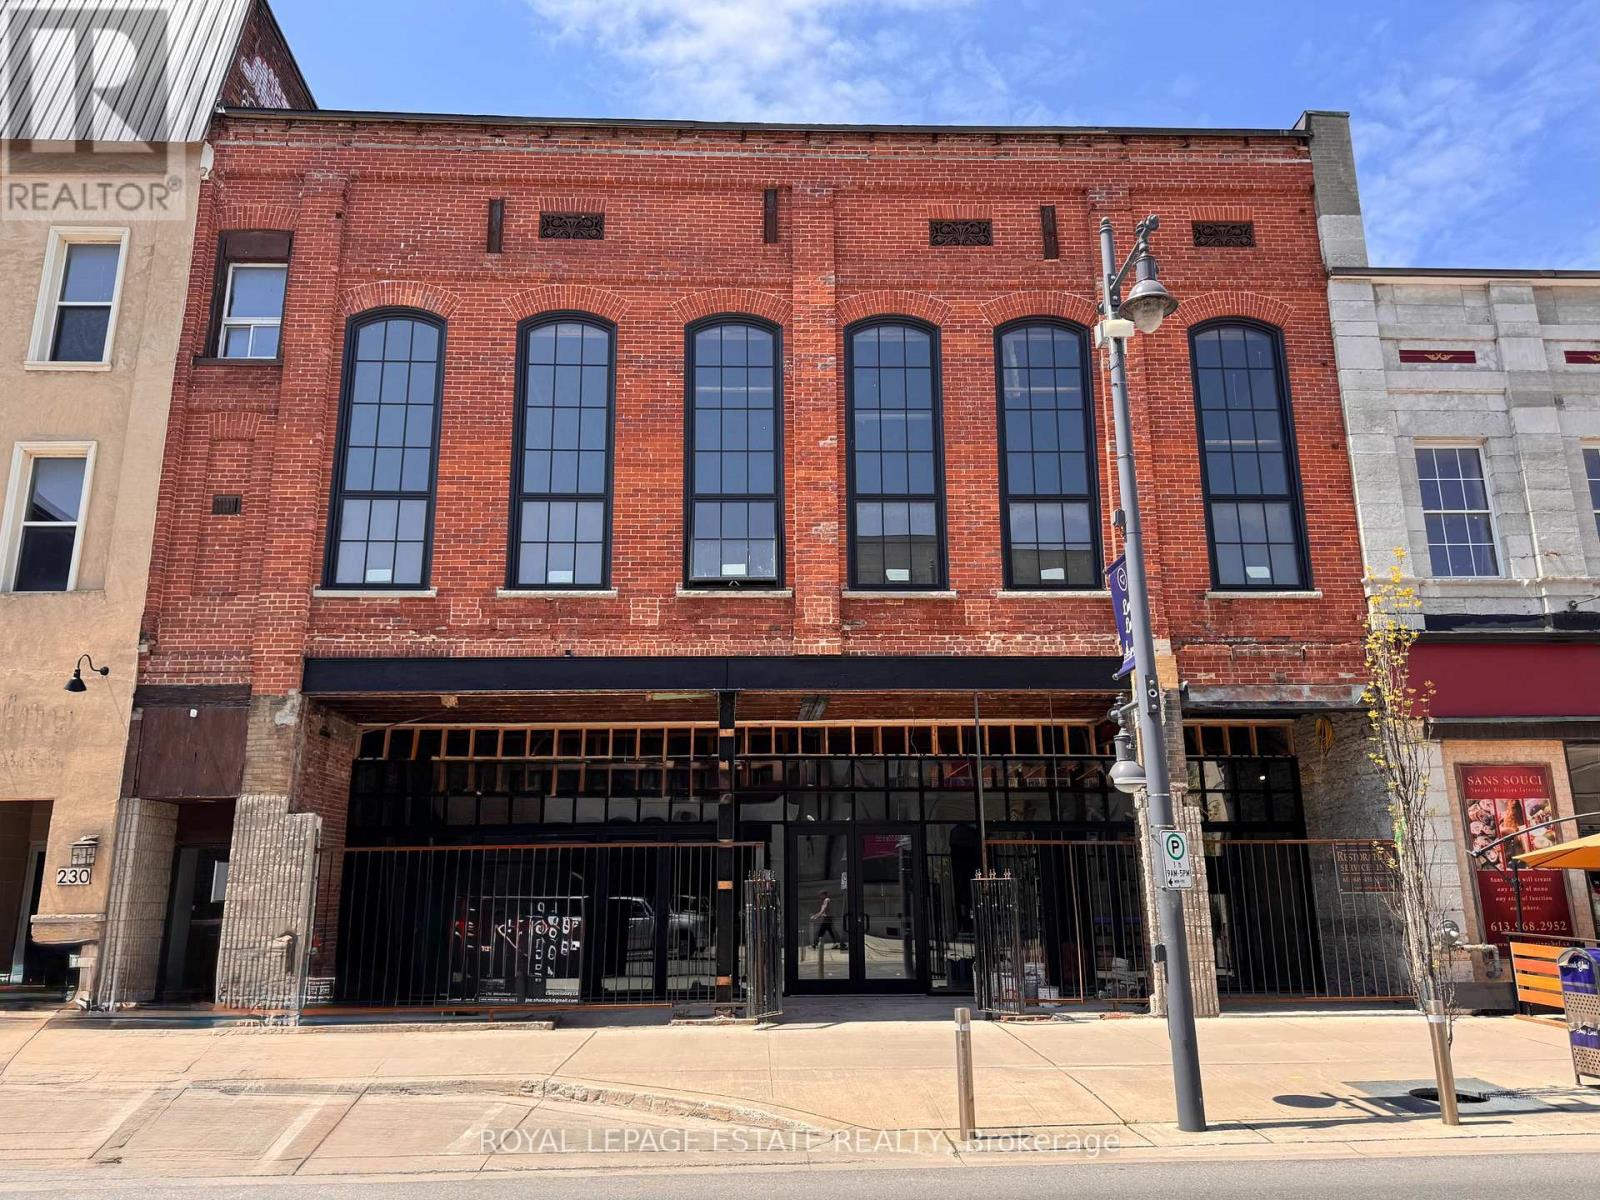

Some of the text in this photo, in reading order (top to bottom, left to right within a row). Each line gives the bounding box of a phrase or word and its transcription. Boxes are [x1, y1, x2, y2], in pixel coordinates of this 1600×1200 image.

[1467, 775, 1542, 785] SANS SOUCI
[1171, 840, 1180, 854] P
[57, 869, 90, 884] 230
